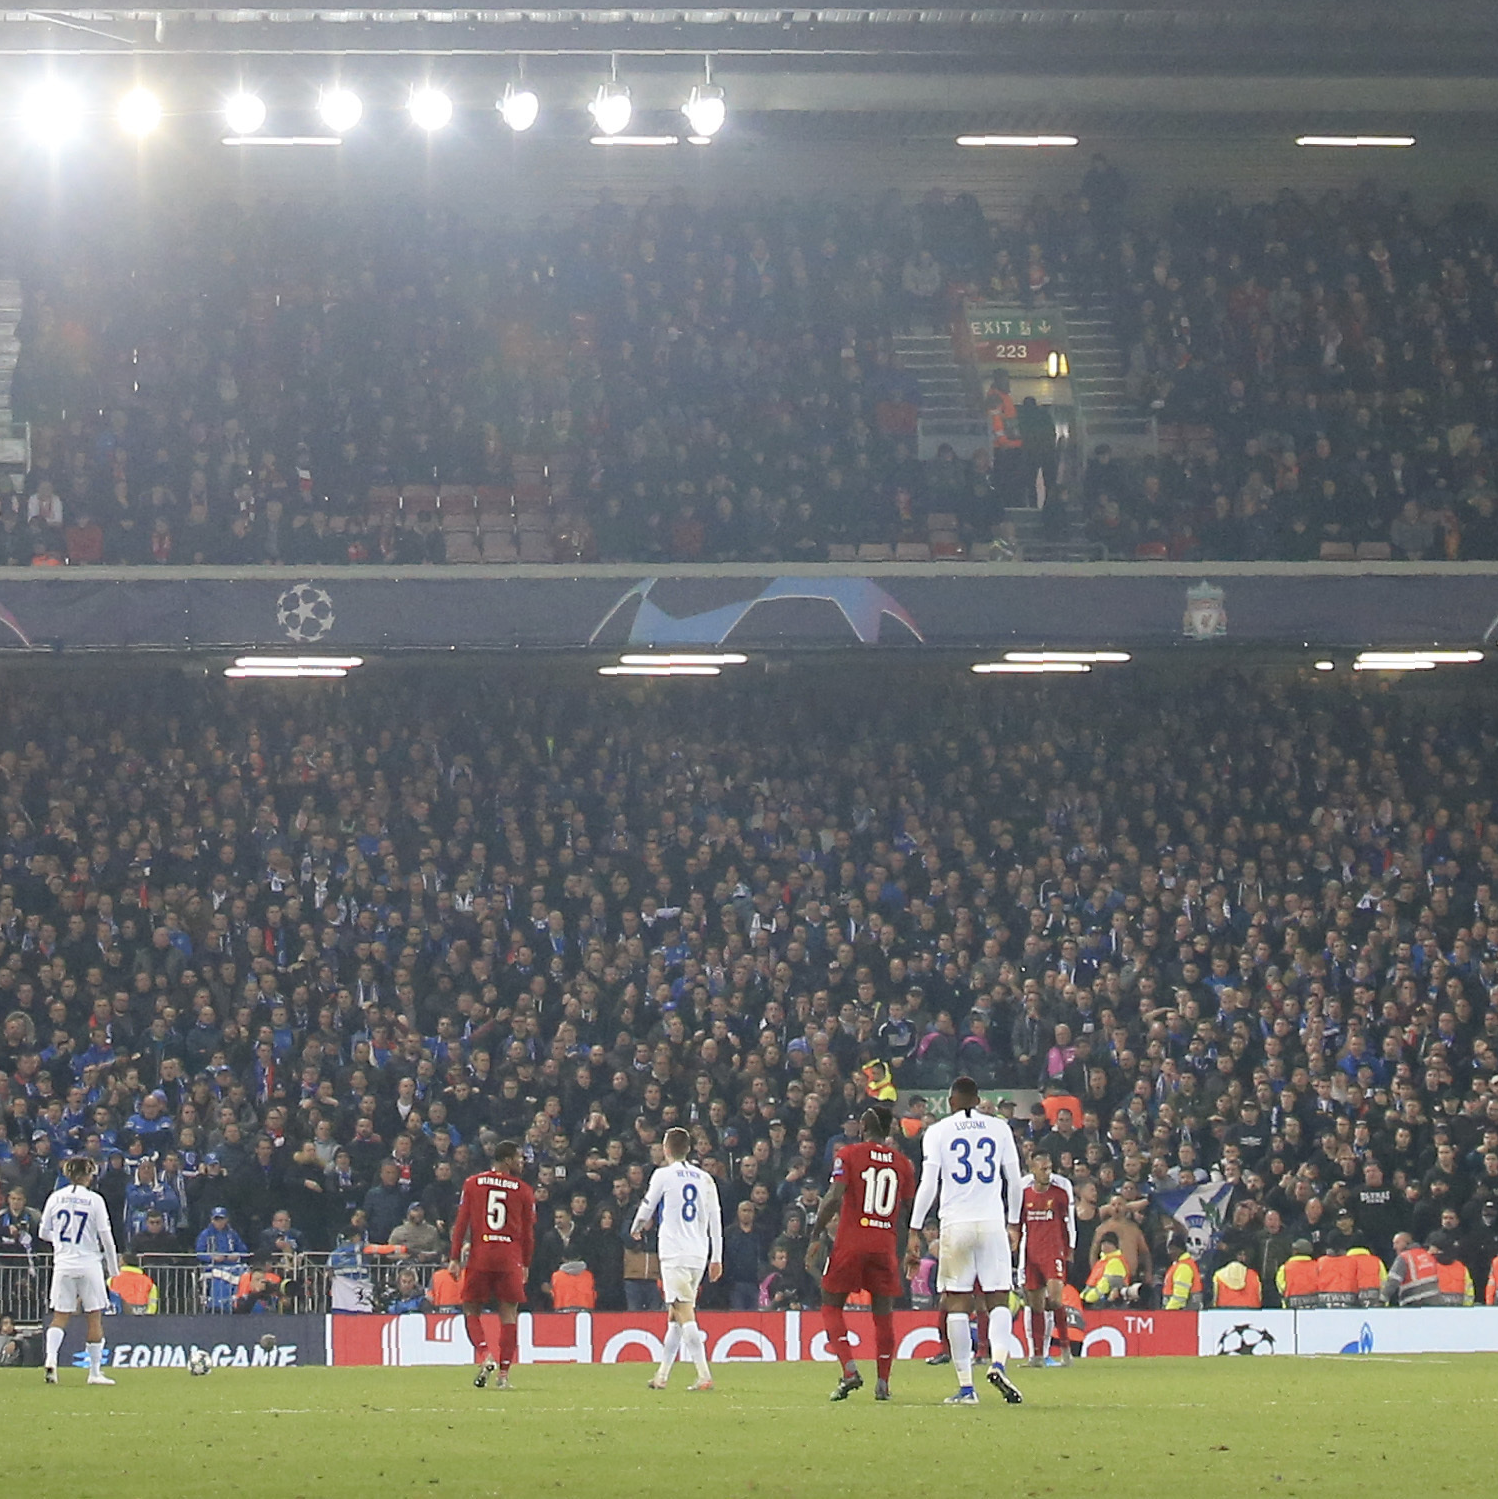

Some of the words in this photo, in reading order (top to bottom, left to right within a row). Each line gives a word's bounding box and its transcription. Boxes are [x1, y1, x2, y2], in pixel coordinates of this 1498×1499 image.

[971, 320, 1012, 335] EXIT
[995, 344, 1028, 358] 223
[950, 1137, 997, 1185] 33
[486, 1189, 507, 1231] 5
[682, 1183, 698, 1223] 8
[861, 1166, 899, 1218] 10
[56, 1209, 89, 1245] 27
[1055, 1258, 1063, 1272] 3
